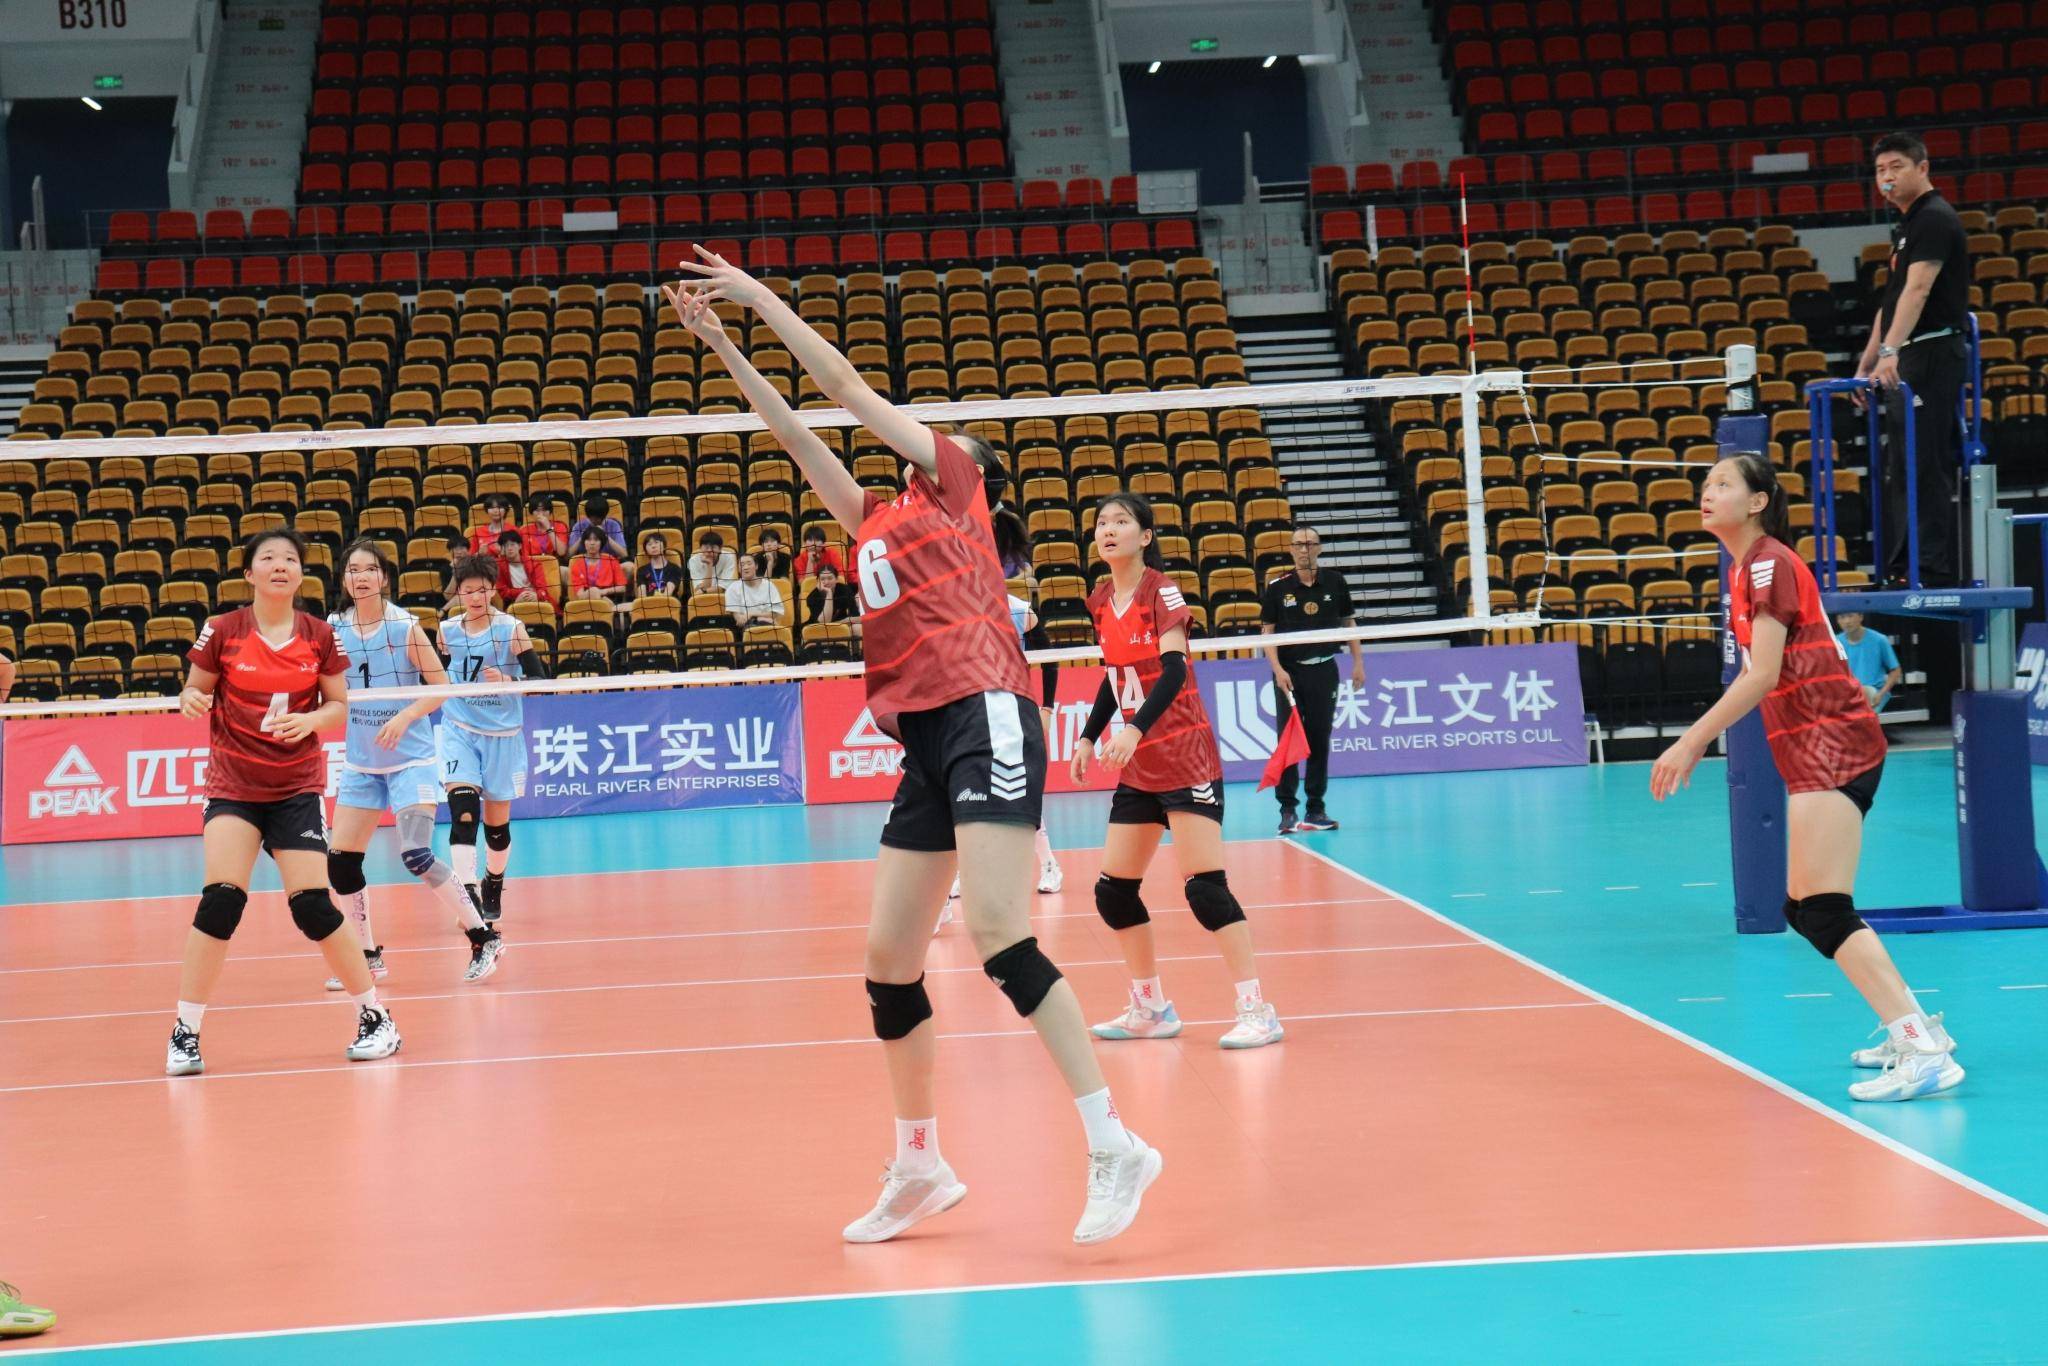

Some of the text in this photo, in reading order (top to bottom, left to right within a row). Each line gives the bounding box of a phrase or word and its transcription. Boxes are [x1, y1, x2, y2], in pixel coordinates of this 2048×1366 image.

[60, 0, 127, 29] B310
[858, 538, 900, 616] 6
[358, 662, 371, 688] 1
[463, 655, 484, 682] 17
[532, 716, 779, 778] 珠江实业
[1331, 737, 1378, 752] EARL
[1382, 734, 1439, 750] RIVER
[1443, 731, 1517, 748] SPORTS
[446, 759, 459, 775] 17
[534, 775, 780, 797] PEARL RIVER ENTERPRISES
[28, 786, 120, 819] PEAK
